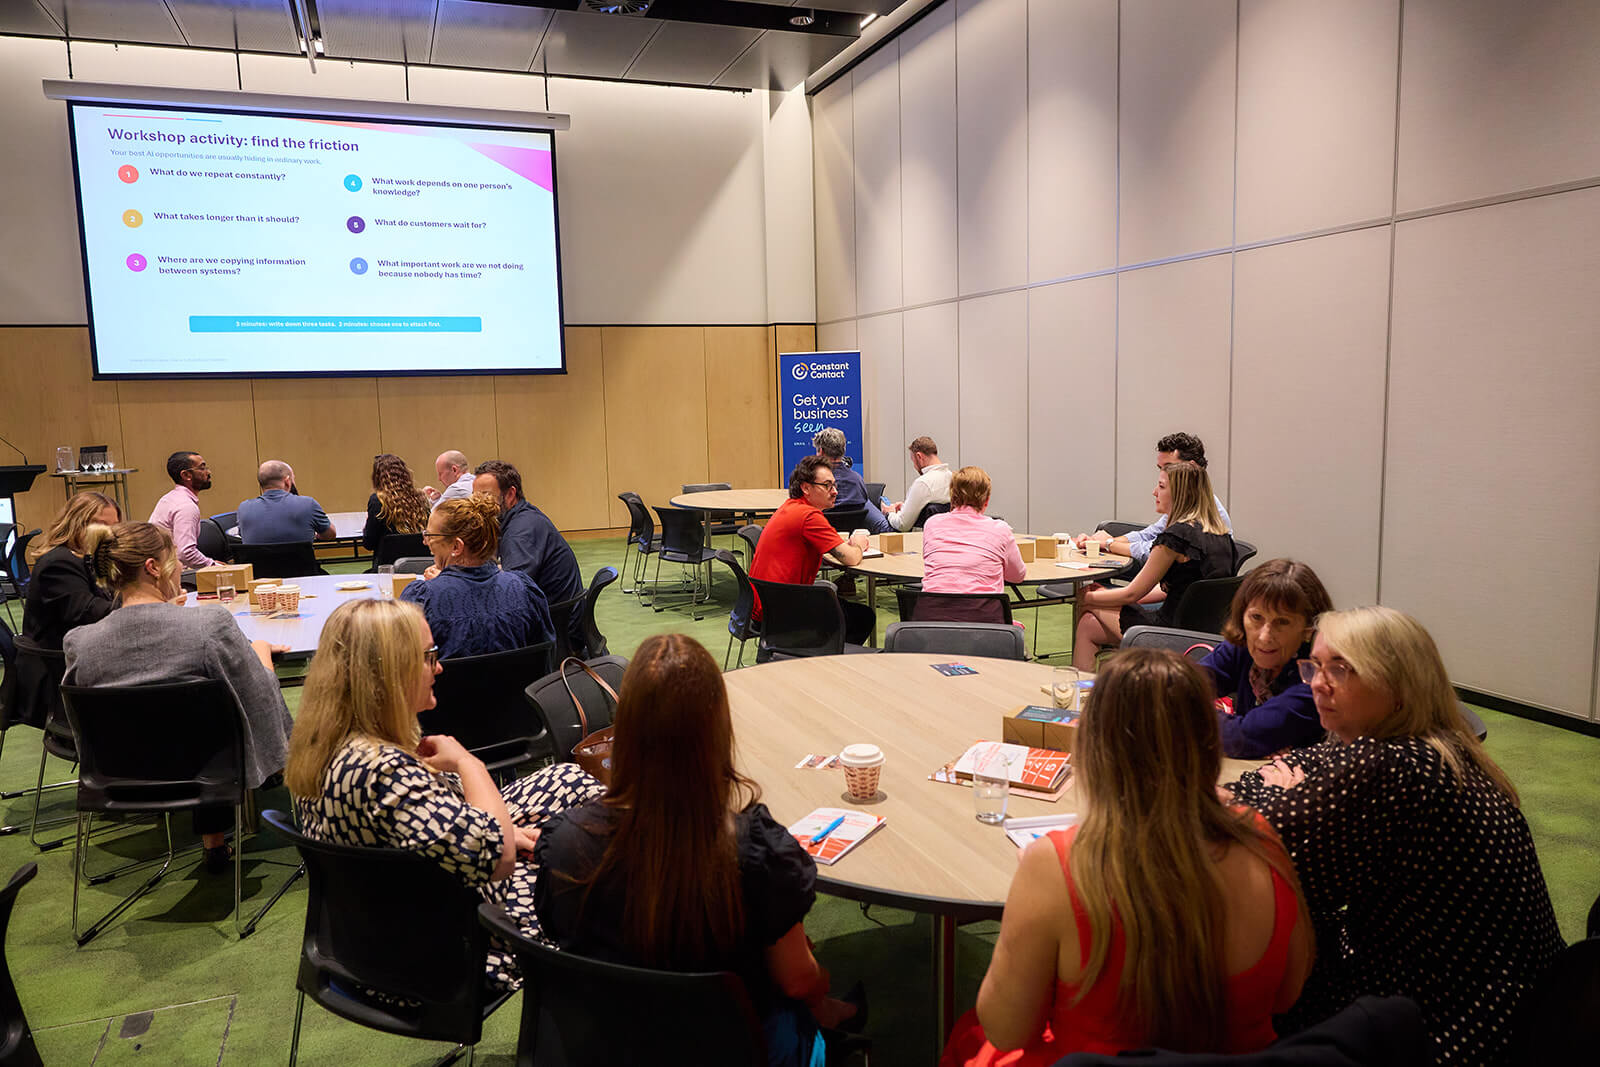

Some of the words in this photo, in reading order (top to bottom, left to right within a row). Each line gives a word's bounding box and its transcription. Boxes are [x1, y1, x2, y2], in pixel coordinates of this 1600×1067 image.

[108, 128, 186, 145] Workshop
[190, 133, 248, 148] activity:
[251, 136, 279, 148] find
[282, 137, 306, 149] the
[309, 138, 359, 151] friction
[205, 171, 233, 179] repeat
[235, 172, 286, 181] constantly?
[416, 180, 450, 188] depends
[373, 188, 420, 197] knowledge?
[206, 214, 234, 222] longer
[220, 258, 255, 266] copying
[401, 260, 440, 269] important
[200, 268, 241, 276] systems?
[414, 271, 443, 279] nobody
[810, 362, 849, 371] Constant
[793, 394, 817, 406] Get
[820, 395, 850, 408] your
[793, 408, 849, 419] business
[794, 422, 824, 433] seen
